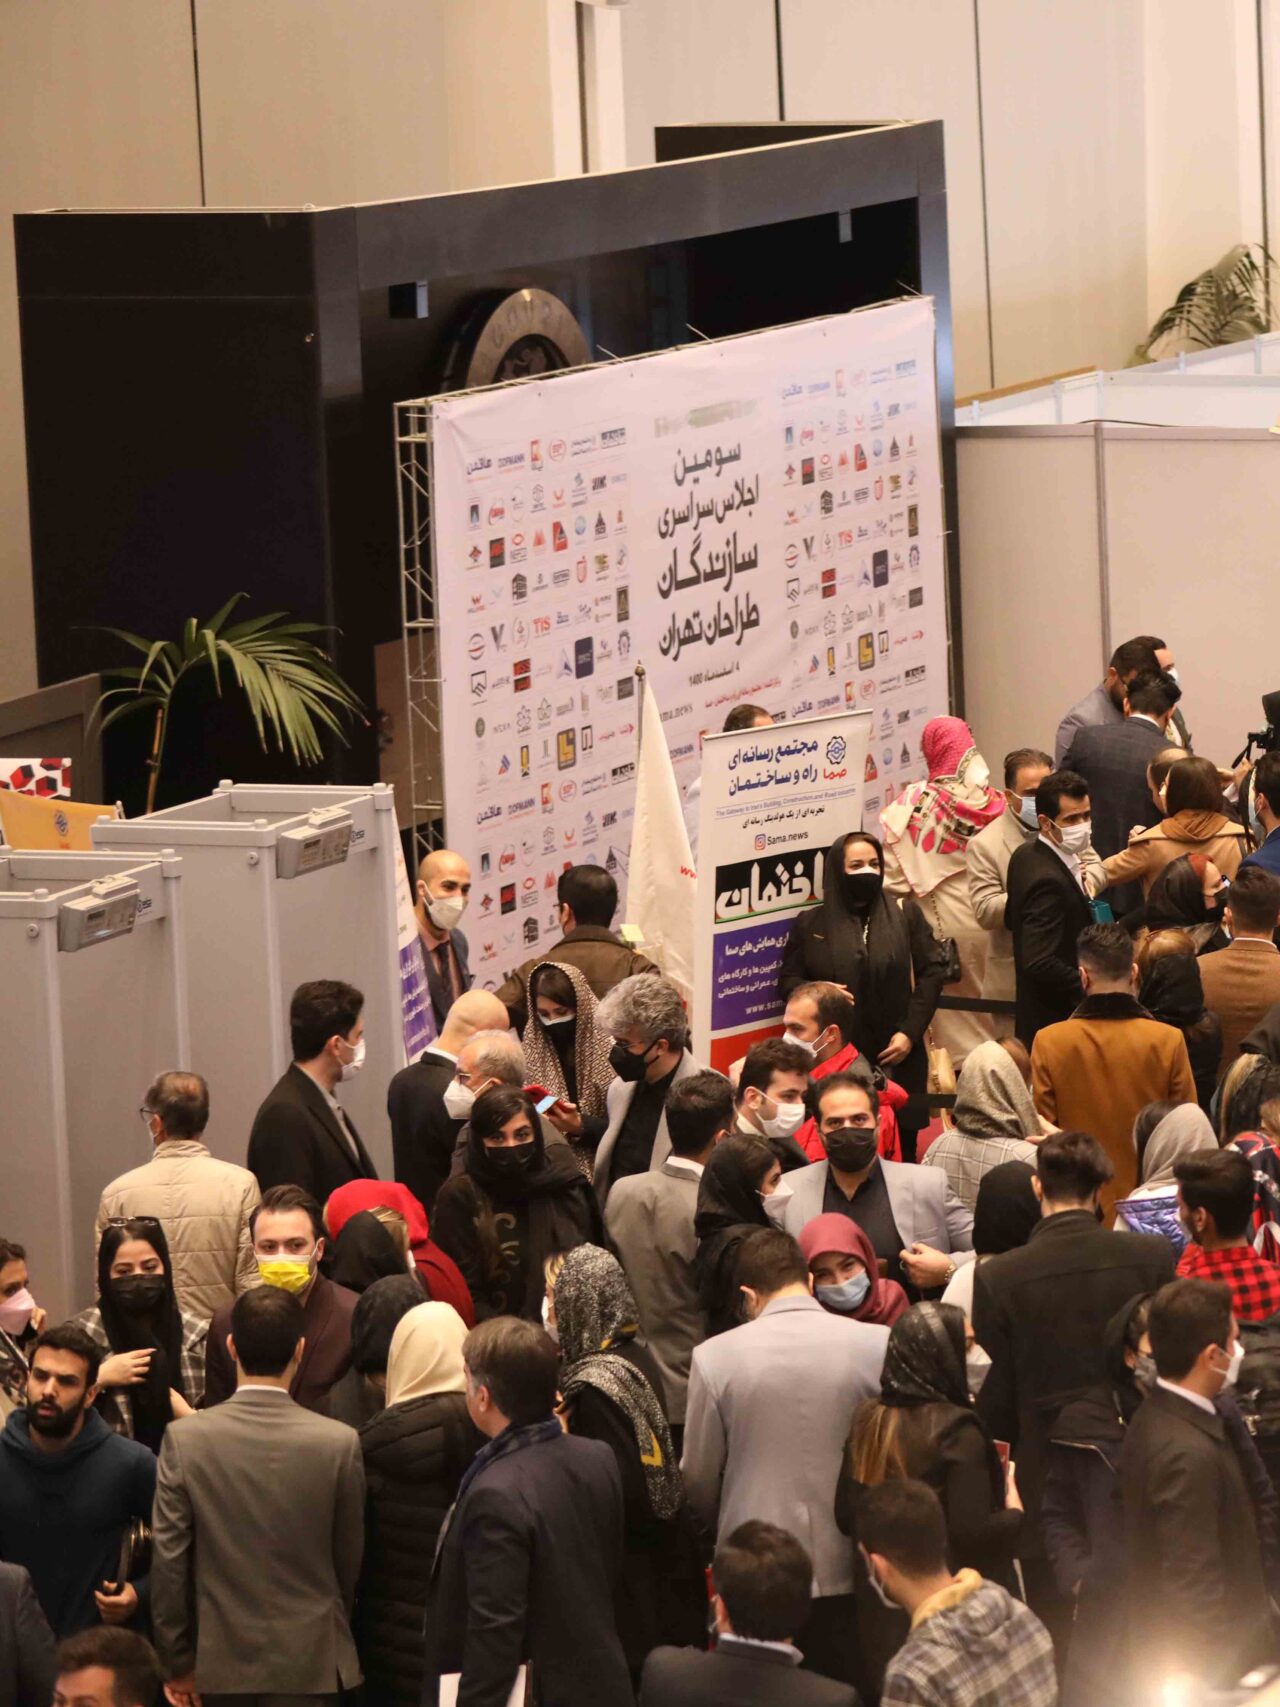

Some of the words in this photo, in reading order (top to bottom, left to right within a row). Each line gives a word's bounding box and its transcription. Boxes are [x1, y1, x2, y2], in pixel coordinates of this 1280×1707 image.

[674, 442, 741, 487] سومین
[715, 473, 759, 524] اجلاس
[658, 490, 714, 539] سراسری
[657, 530, 758, 600] سازندگان
[704, 591, 760, 646] طراحان
[659, 610, 703, 662] تهران
[728, 749, 741, 771] ای
[742, 744, 774, 763] رسانه
[775, 739, 819, 764] مجتمع
[728, 768, 792, 796] ساختمان
[794, 769, 799, 786] و
[802, 764, 818, 783] راه
[823, 767, 848, 780] صما
[767, 831, 809, 846] Sama.news
[715, 850, 825, 920] اختمان
[725, 944, 739, 956] صما
[745, 1000, 786, 1015] www.sam
